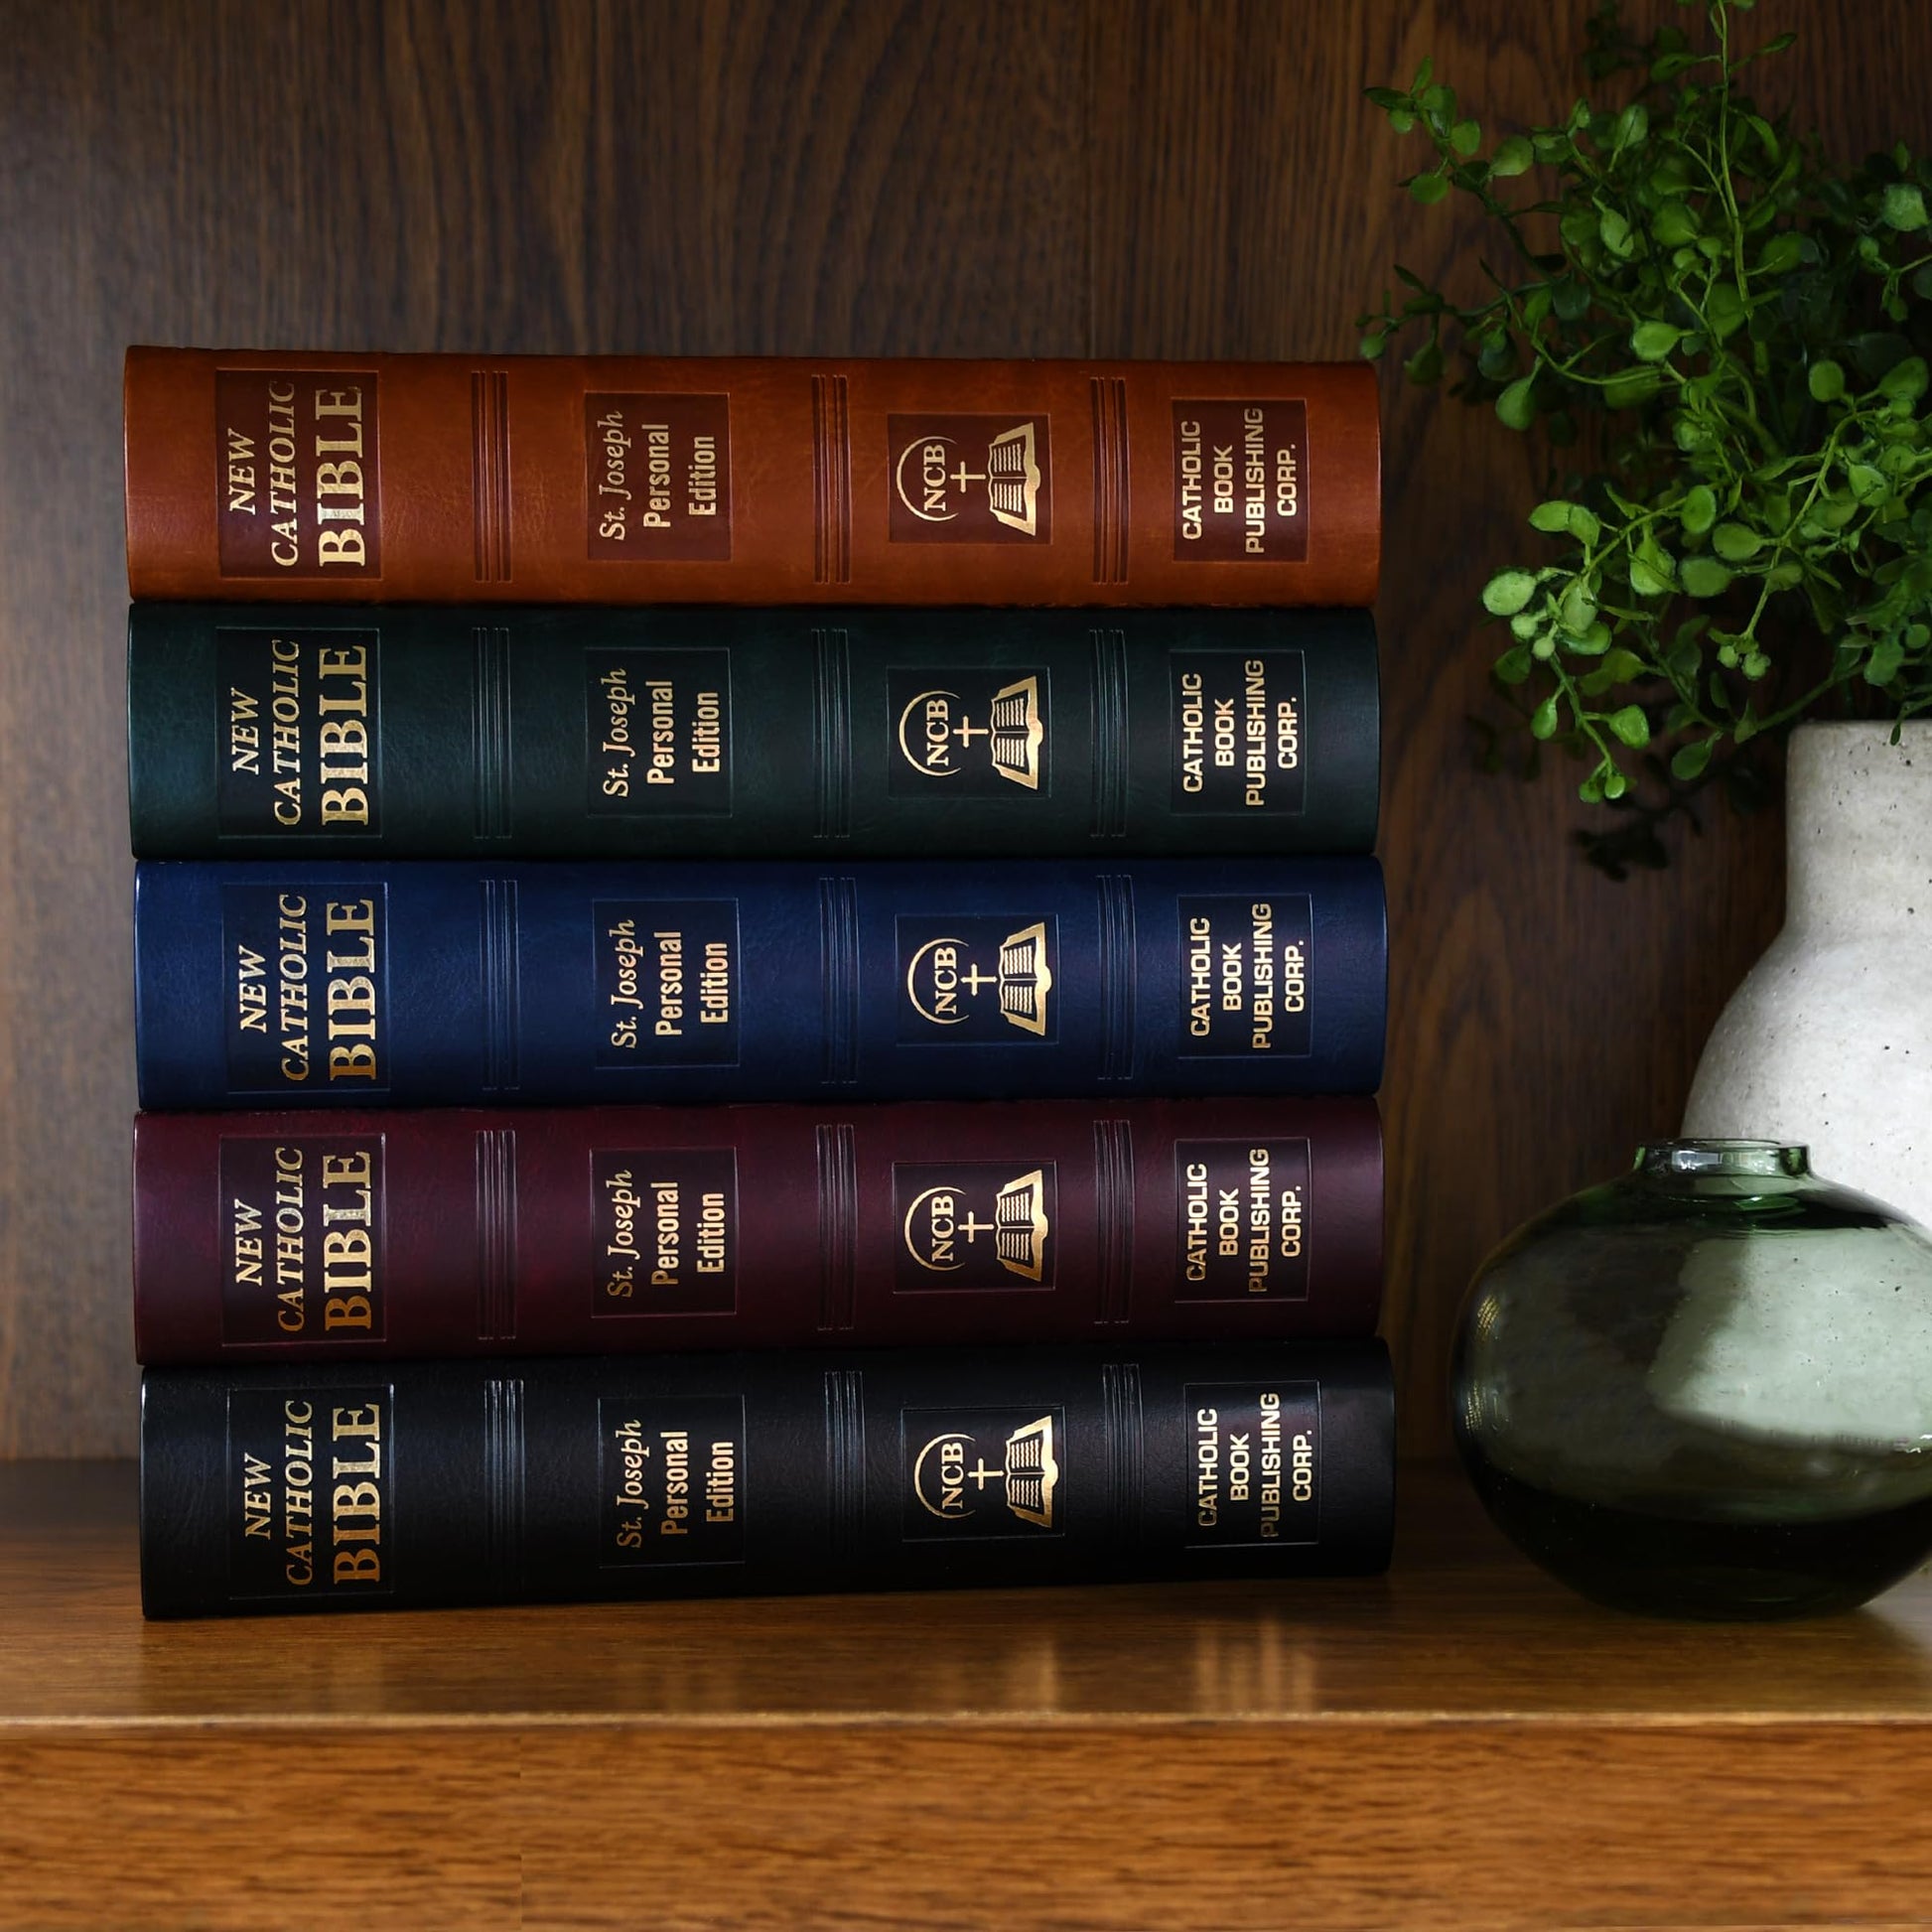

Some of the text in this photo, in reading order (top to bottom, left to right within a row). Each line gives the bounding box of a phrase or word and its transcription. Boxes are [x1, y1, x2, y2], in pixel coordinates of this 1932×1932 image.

[227, 427, 256, 516] NEW
[268, 379, 300, 568] CATHOLIC
[315, 384, 366, 568] BIBLE
[597, 411, 632, 541] St. Joseph
[640, 423, 672, 528] Personal
[687, 436, 717, 516] Edition
[922, 444, 947, 512] NCB
[1180, 420, 1203, 540] CATHOLIC
[1213, 445, 1234, 513] BOOK
[1244, 408, 1267, 554] PUBLISHING
[1276, 444, 1298, 517] CORP.
[230, 686, 260, 775] NEW
[271, 638, 302, 826] CATHOLIC
[318, 645, 369, 826] BIBLE
[600, 668, 636, 797] St. Joseph
[644, 680, 675, 784] Personal
[691, 692, 721, 773] Edition
[925, 699, 950, 767] NCB
[1181, 673, 1204, 793] CATHOLIC
[1214, 698, 1235, 767] BOOK
[1244, 659, 1267, 806] PUBLISHING
[1277, 697, 1299, 769] CORP.
[237, 944, 267, 1034] NEW
[278, 894, 310, 1081] CATHOLIC
[326, 898, 376, 1081] BIBLE
[608, 918, 644, 1049] St. Joseph
[652, 931, 684, 1036] Personal
[699, 942, 729, 1024] Edition
[933, 946, 958, 1015] NCB
[1189, 917, 1212, 1036] CATHOLIC
[1221, 942, 1243, 1011] BOOK
[1250, 902, 1275, 1049] PUBLISHING
[1284, 939, 1305, 1013] CORP.
[233, 1197, 263, 1287] NEW
[274, 1147, 305, 1331] CATHOLIC
[322, 1151, 372, 1331] BIBLE
[605, 1170, 641, 1298] St. Joseph
[649, 1181, 680, 1285] Personal
[696, 1192, 726, 1273] Edition
[930, 1194, 955, 1262] NCB
[1185, 1163, 1208, 1282] CATHOLIC
[1218, 1187, 1240, 1256] BOOK
[1248, 1148, 1272, 1293] PUBLISHING
[1281, 1184, 1303, 1257] CORP.
[243, 1451, 272, 1540] NEW
[284, 1400, 314, 1586] CATHOLIC
[332, 1403, 381, 1585] BIBLE
[615, 1419, 650, 1549] St. Joseph
[658, 1431, 689, 1535] Personal
[705, 1442, 735, 1522] Edition
[940, 1442, 965, 1510] NCB
[1196, 1408, 1219, 1527] CATHOLIC
[1229, 1432, 1250, 1501] BOOK
[1258, 1392, 1282, 1538] PUBLISHING
[1292, 1430, 1313, 1502] CORP.
